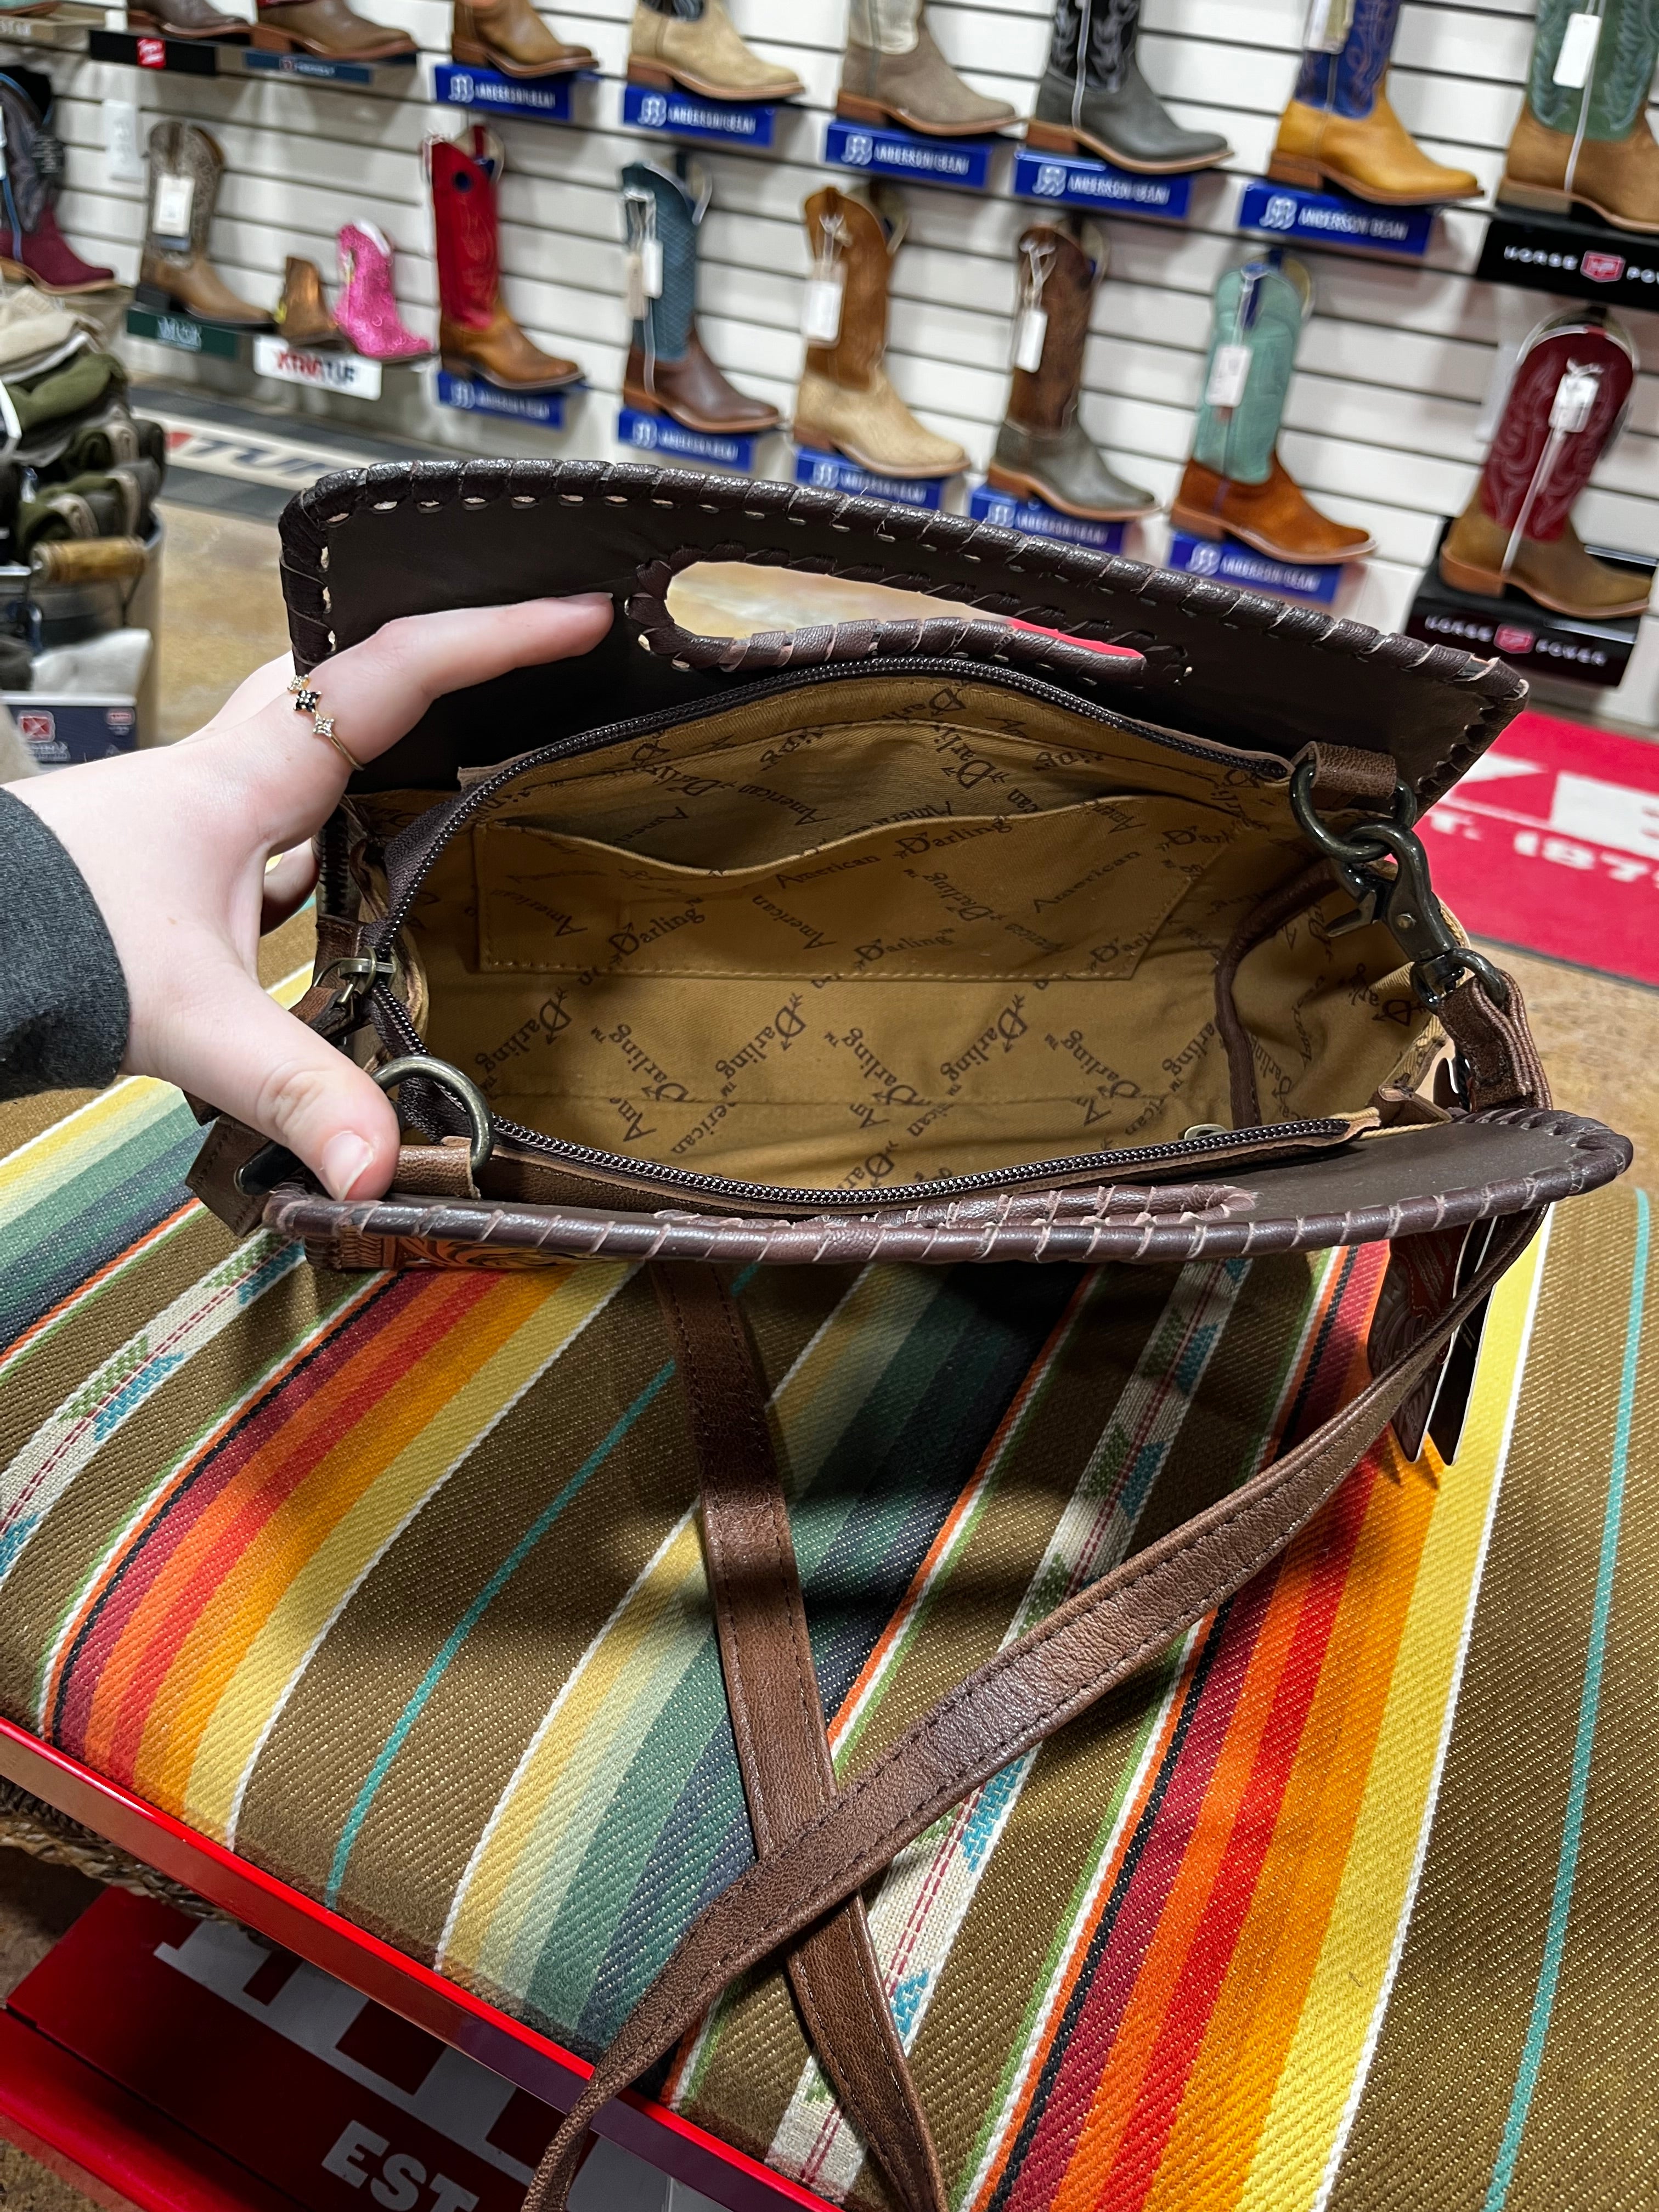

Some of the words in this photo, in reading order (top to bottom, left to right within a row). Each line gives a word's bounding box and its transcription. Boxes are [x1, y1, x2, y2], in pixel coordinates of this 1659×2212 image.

[776, 854, 882, 889] American
[1513, 830, 1659, 890] 187
[608, 904, 706, 956] Darling
[752, 895, 838, 950] American
[475, 999, 572, 1074] Darling
[610, 1023, 690, 1102] Darling
[715, 1006, 807, 1081] Darling
[841, 1027, 918, 1107] Darling
[940, 1008, 1028, 1083] Darling
[1060, 1029, 1141, 1098] Darling
[1161, 1022, 1215, 1076] arling
